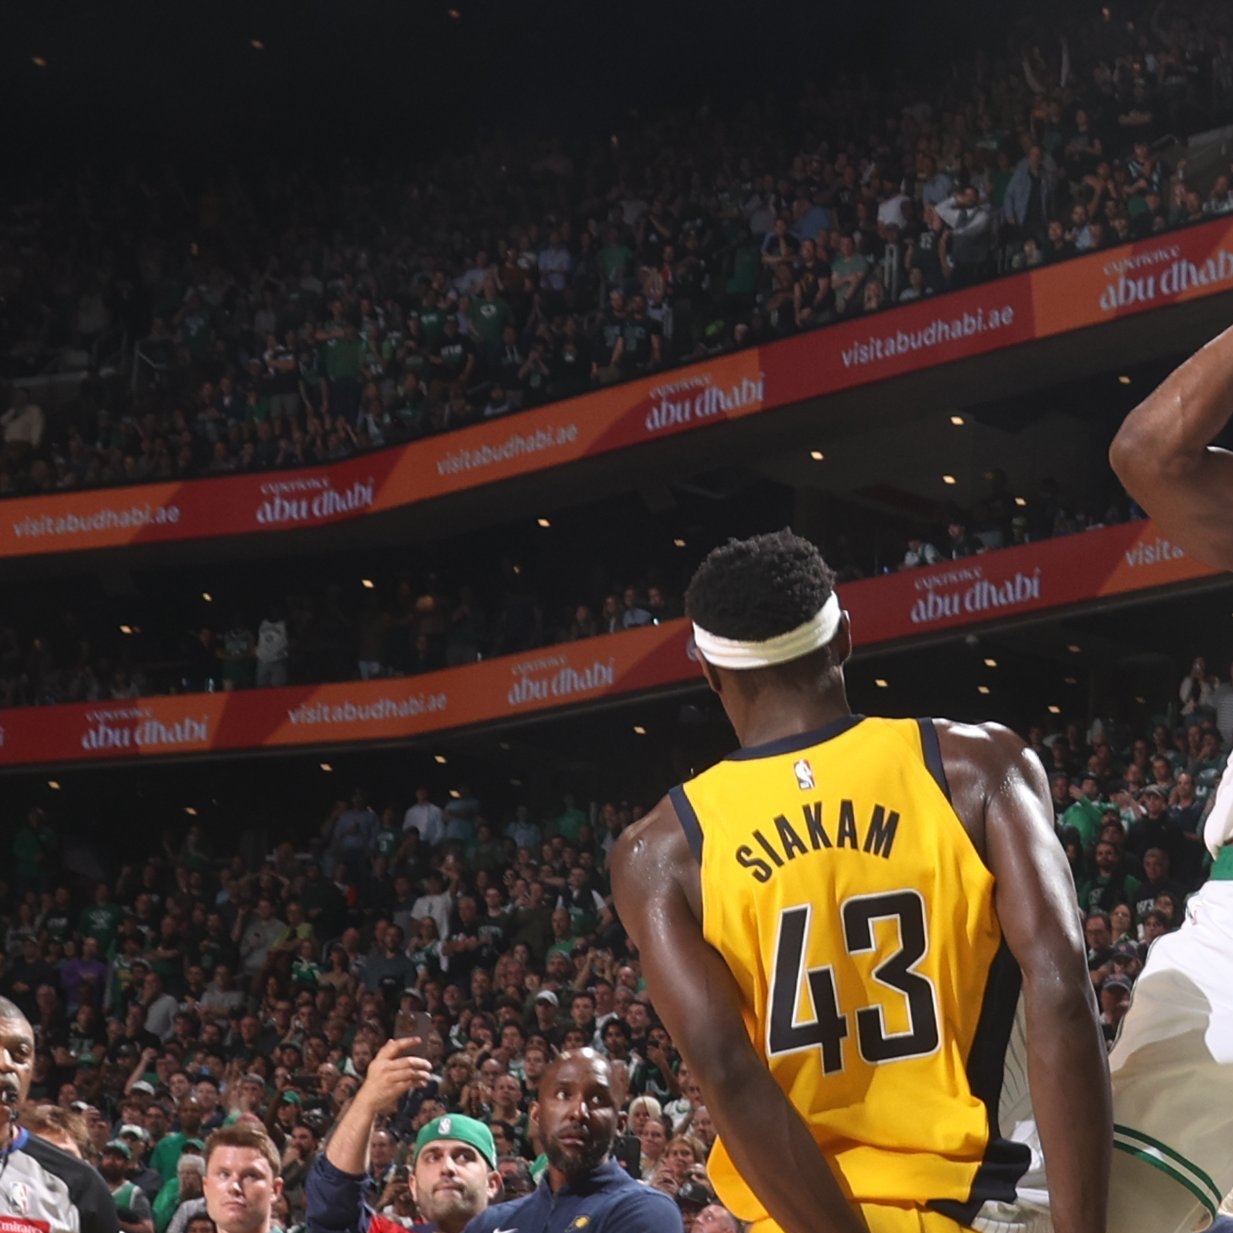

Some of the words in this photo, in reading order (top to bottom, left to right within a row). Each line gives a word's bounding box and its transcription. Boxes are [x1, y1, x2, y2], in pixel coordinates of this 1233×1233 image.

[1100, 275, 1157, 311] abu
[841, 303, 1014, 369] visitabudhabi.ae
[645, 397, 691, 433] abu
[694, 371, 766, 418] dhabi
[436, 422, 579, 476] visitabudhabi.ae
[12, 503, 182, 538] visitabudhabi.ae
[911, 590, 960, 624] abu
[964, 566, 1041, 612] dhabi
[735, 799, 900, 883] SIAKAM
[767, 888, 942, 1077] 43
